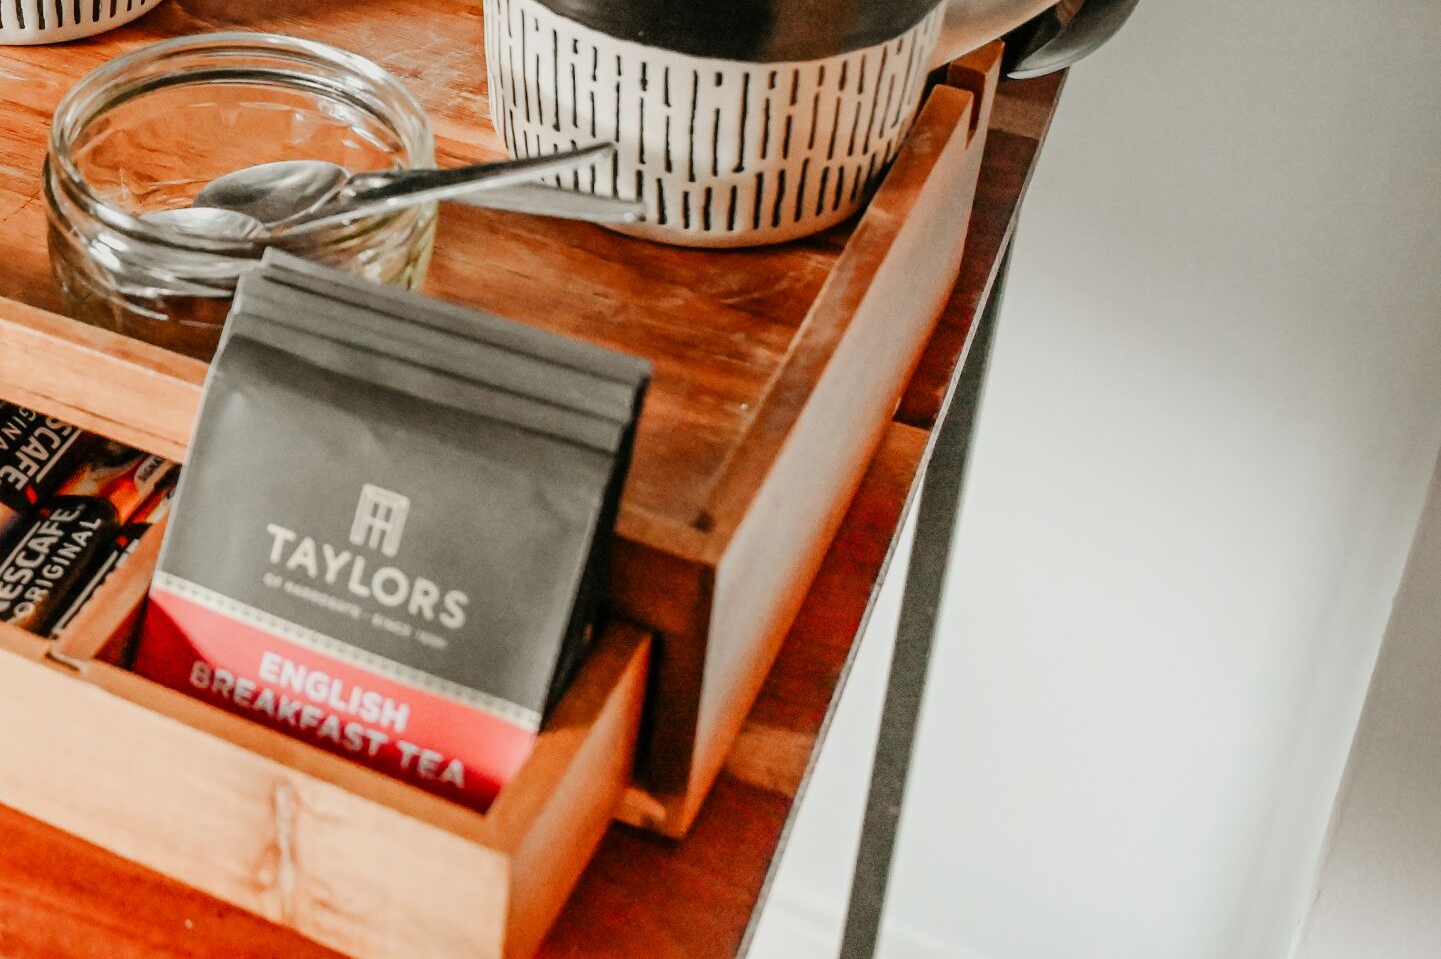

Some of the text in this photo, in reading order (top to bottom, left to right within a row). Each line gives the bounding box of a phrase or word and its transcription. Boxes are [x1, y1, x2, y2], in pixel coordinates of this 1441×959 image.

[13, 518, 102, 619] ORIGINAL
[266, 523, 471, 630] TAYLORS
[189, 660, 465, 789] BREAKFAST TEA
[258, 649, 411, 734] ENGLISH
